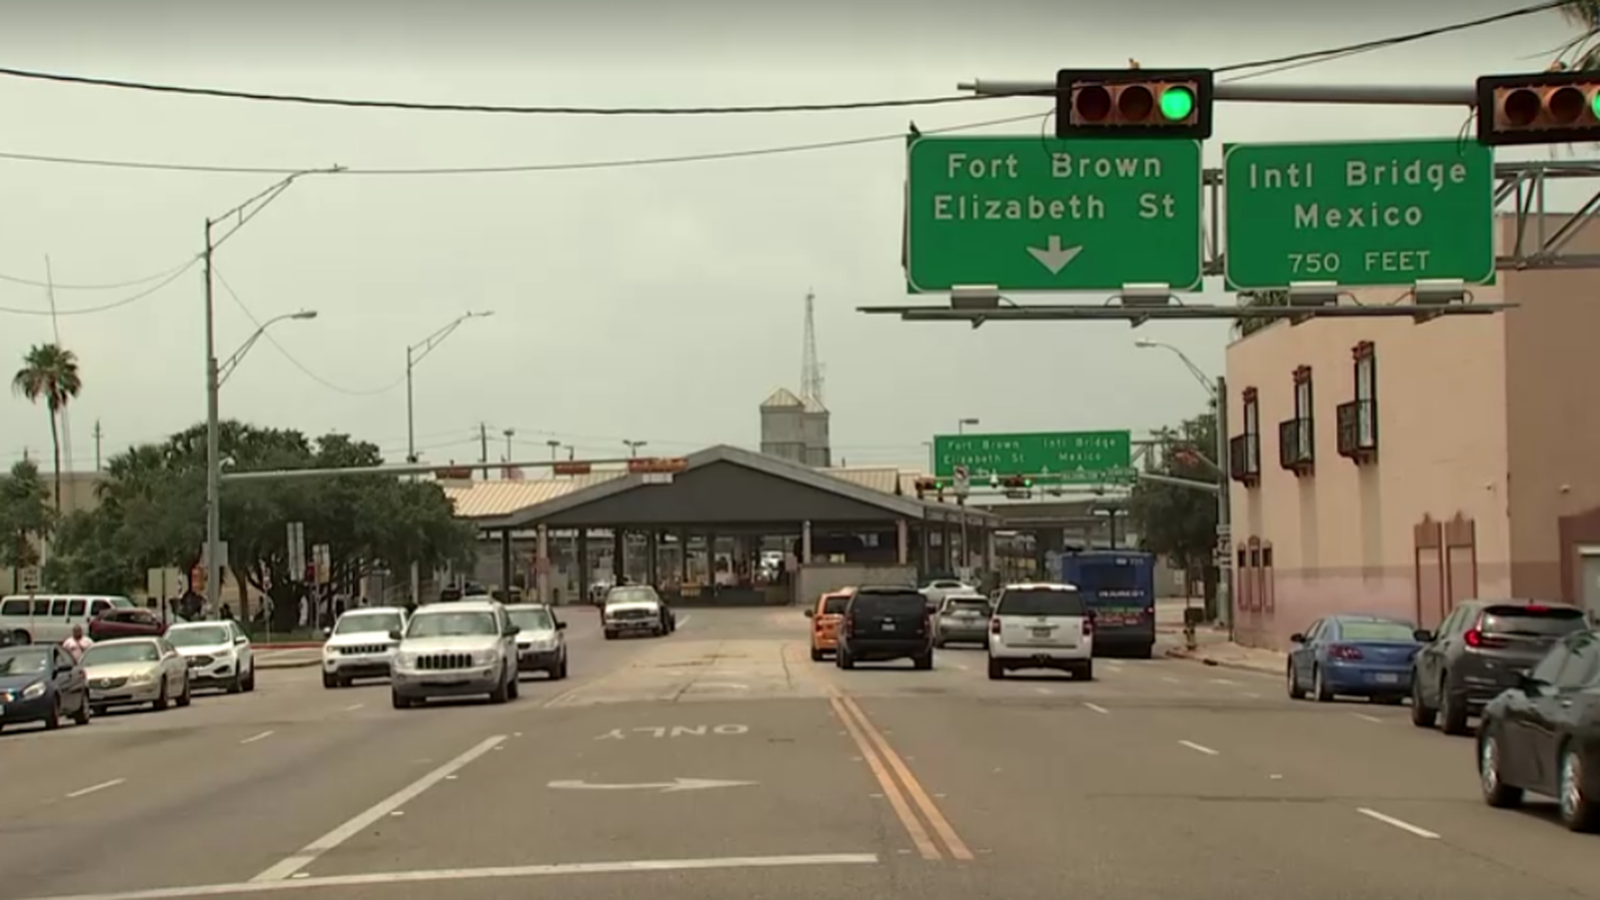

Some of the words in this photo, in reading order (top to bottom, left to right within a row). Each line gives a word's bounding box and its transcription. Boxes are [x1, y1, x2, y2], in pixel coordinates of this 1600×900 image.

[948, 153, 1018, 178] Fort
[1051, 152, 1162, 178] Brown
[1249, 162, 1313, 188] Intl
[1346, 159, 1467, 192] Bridge
[934, 195, 1105, 220] Elizabeth
[1138, 193, 1175, 218] St
[1294, 202, 1423, 230] Mexico
[1287, 252, 1340, 273] 750
[1365, 251, 1430, 271] FEET
[949, 440, 972, 450] Fort
[982, 438, 1020, 449] Brown
[1075, 437, 1116, 449] Bridge
[1059, 452, 1101, 461] Mexico
[593, 724, 749, 740] ONLY
